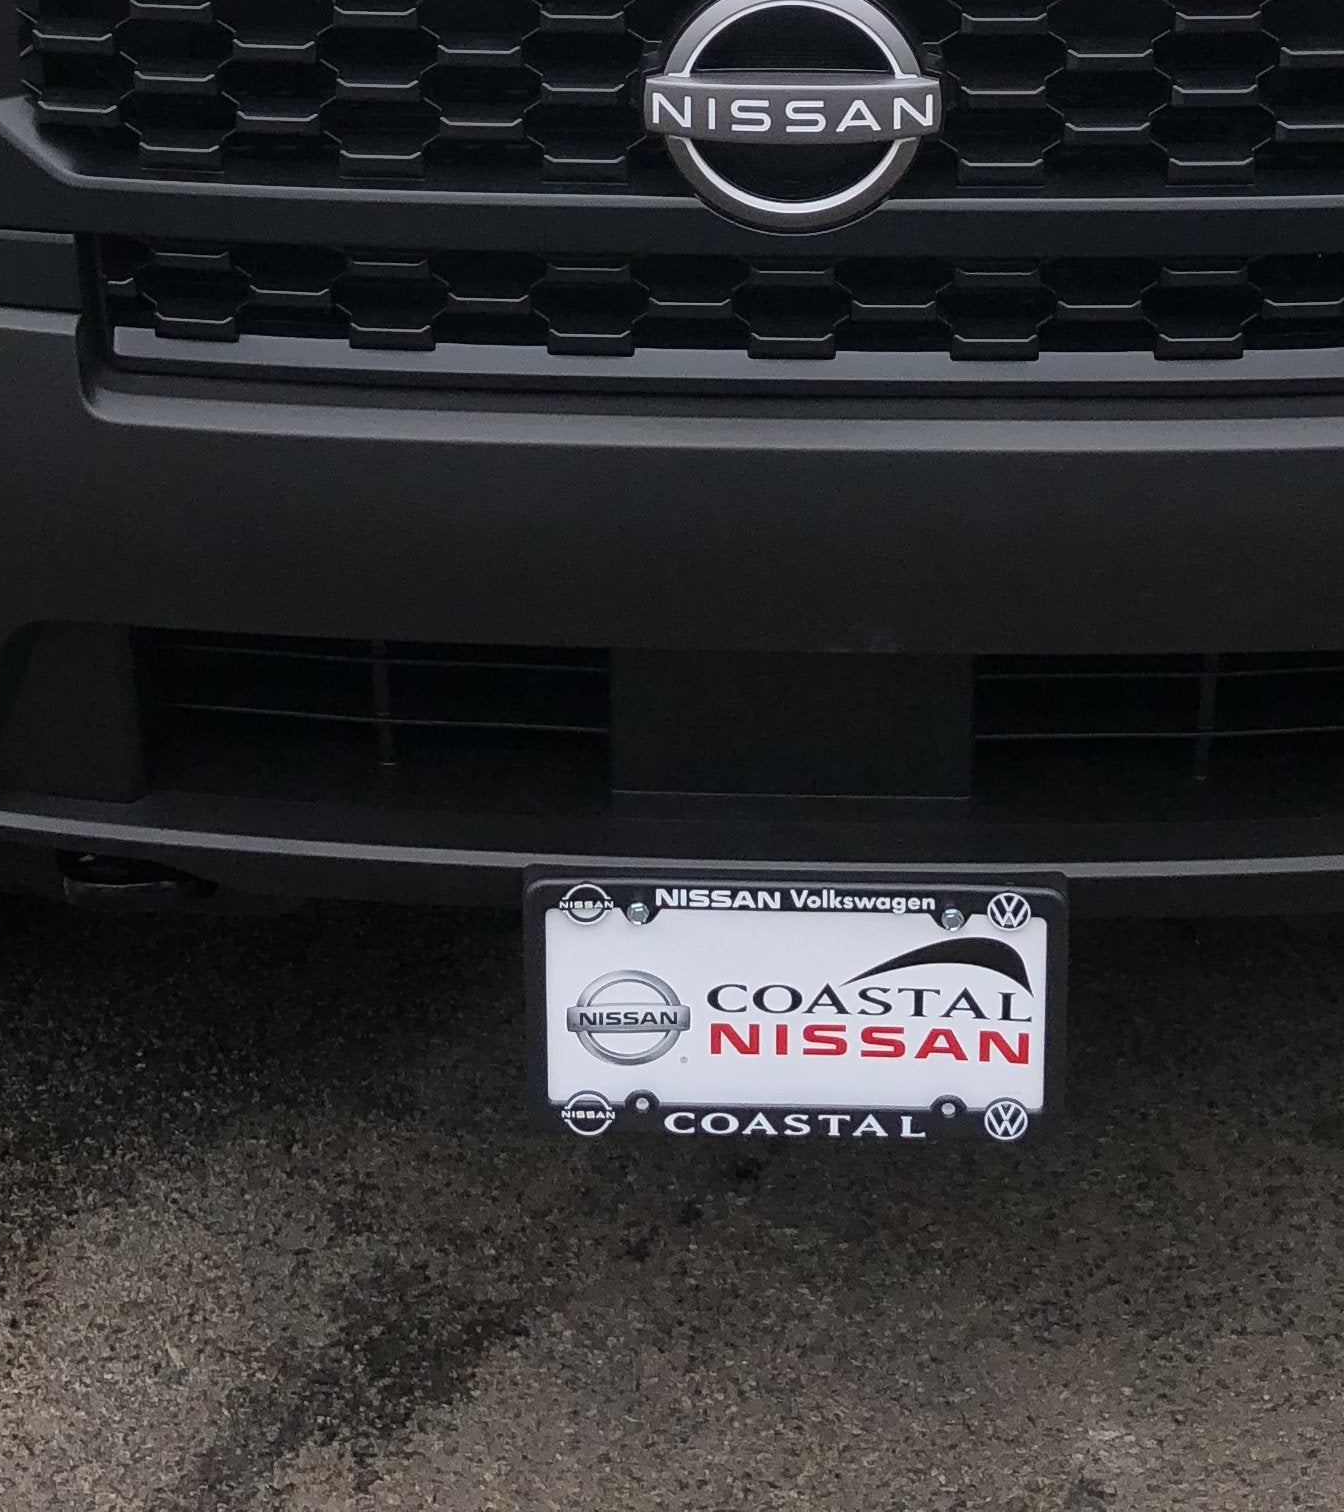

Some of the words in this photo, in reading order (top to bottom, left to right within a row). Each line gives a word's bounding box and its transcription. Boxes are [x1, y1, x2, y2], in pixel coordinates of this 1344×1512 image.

[651, 91, 935, 133] NISSAN
[558, 900, 614, 909] NISSAN
[656, 888, 781, 909] NISSAN
[790, 889, 936, 914] Volkswagen
[706, 983, 1032, 1023] COASTAL
[579, 1010, 678, 1026] NISSAN
[710, 1023, 1030, 1065] NISSAN
[561, 1109, 616, 1120] NISSAN
[664, 1111, 925, 1138] COASTAL
